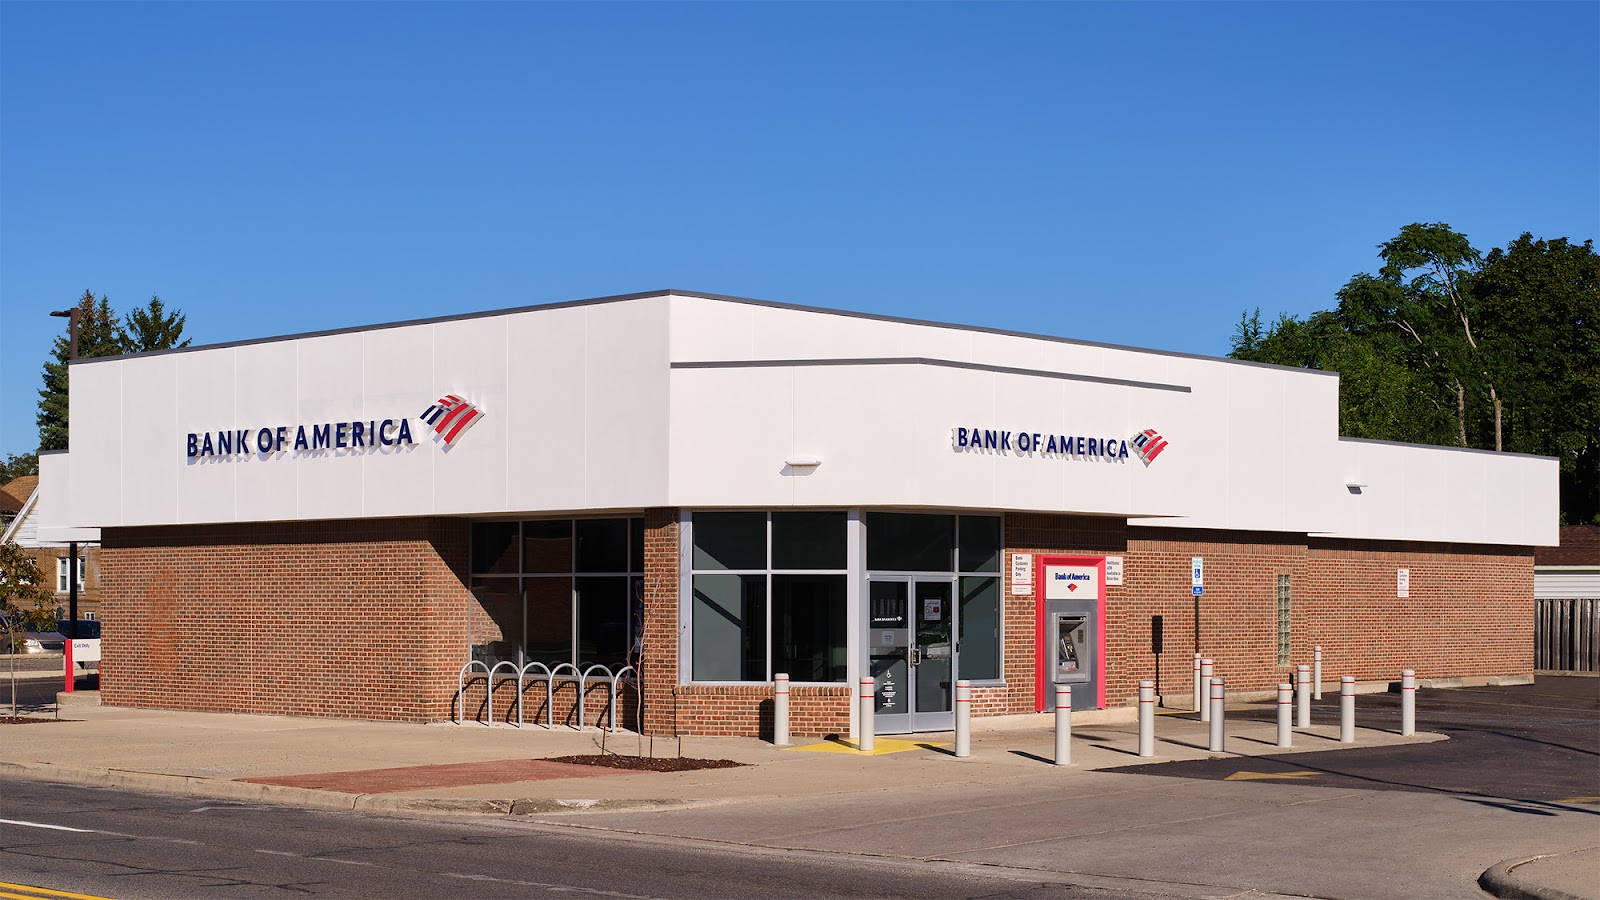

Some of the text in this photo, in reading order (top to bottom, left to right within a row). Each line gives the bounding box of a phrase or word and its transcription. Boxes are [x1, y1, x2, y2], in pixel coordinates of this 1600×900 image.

[187, 418, 413, 457] BANK OF AMERICA
[958, 427, 1129, 458] BANK OF AMERICA
